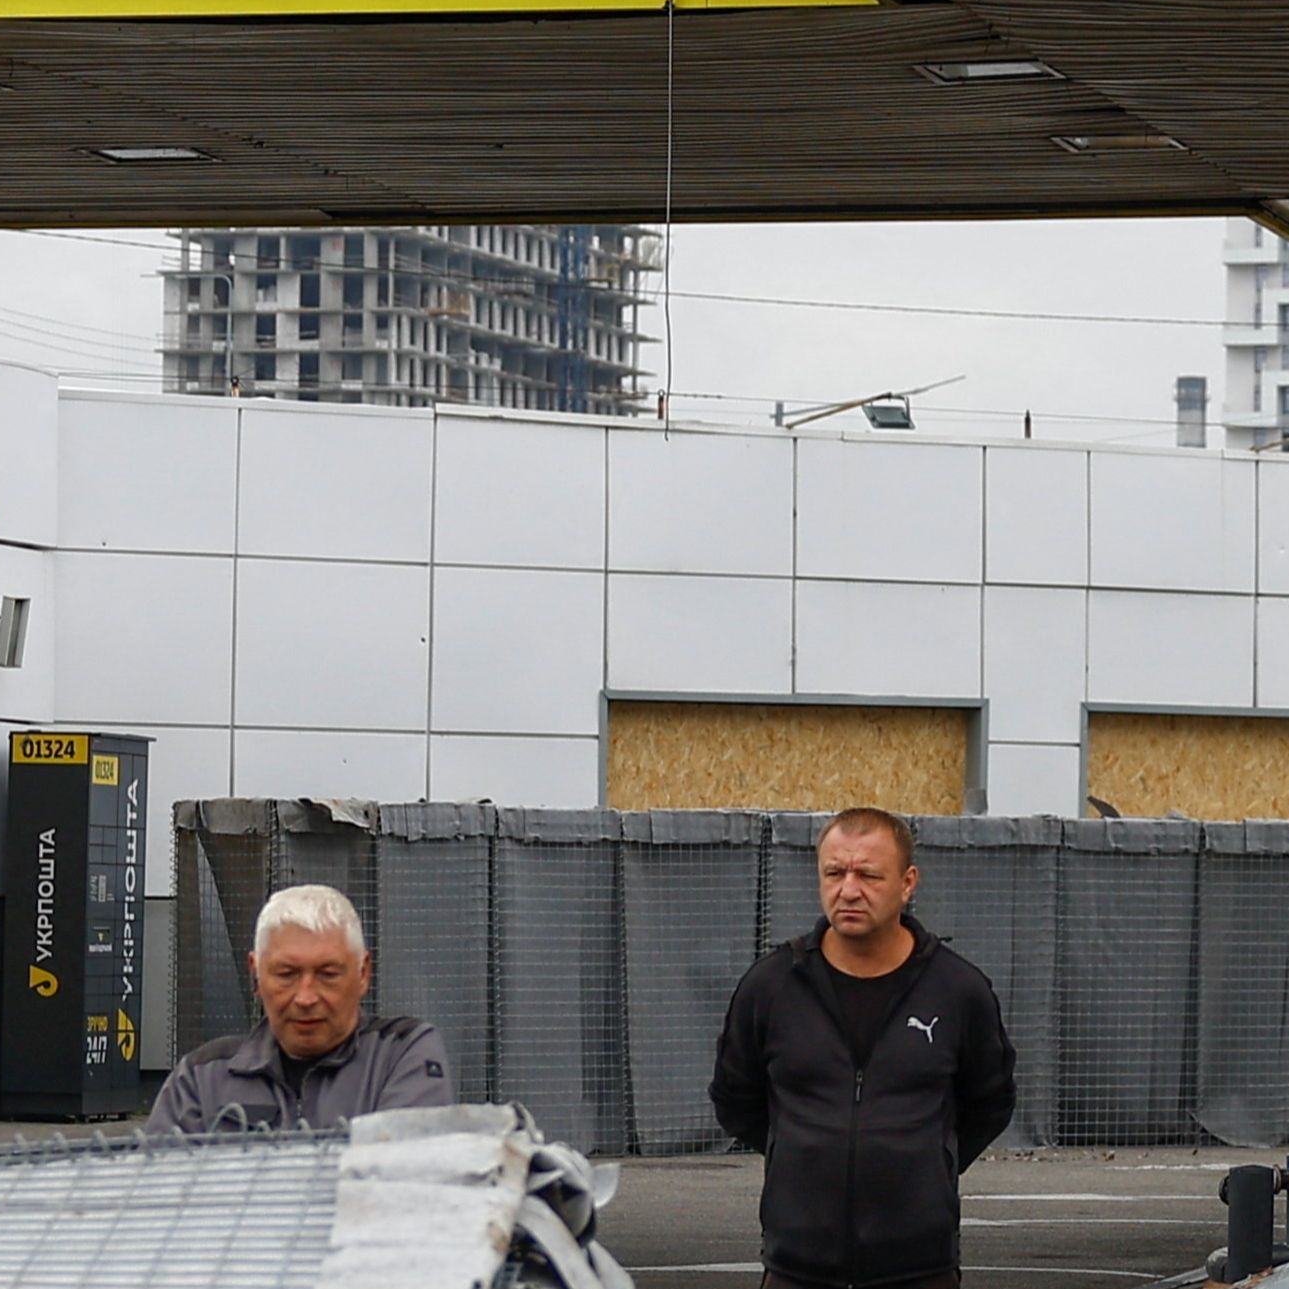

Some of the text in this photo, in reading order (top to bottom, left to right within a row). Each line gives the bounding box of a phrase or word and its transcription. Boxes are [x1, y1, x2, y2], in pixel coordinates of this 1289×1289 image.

[22, 739, 75, 759] 01324
[95, 760, 114, 780] 01324
[36, 827, 56, 962] УКРПОШТА
